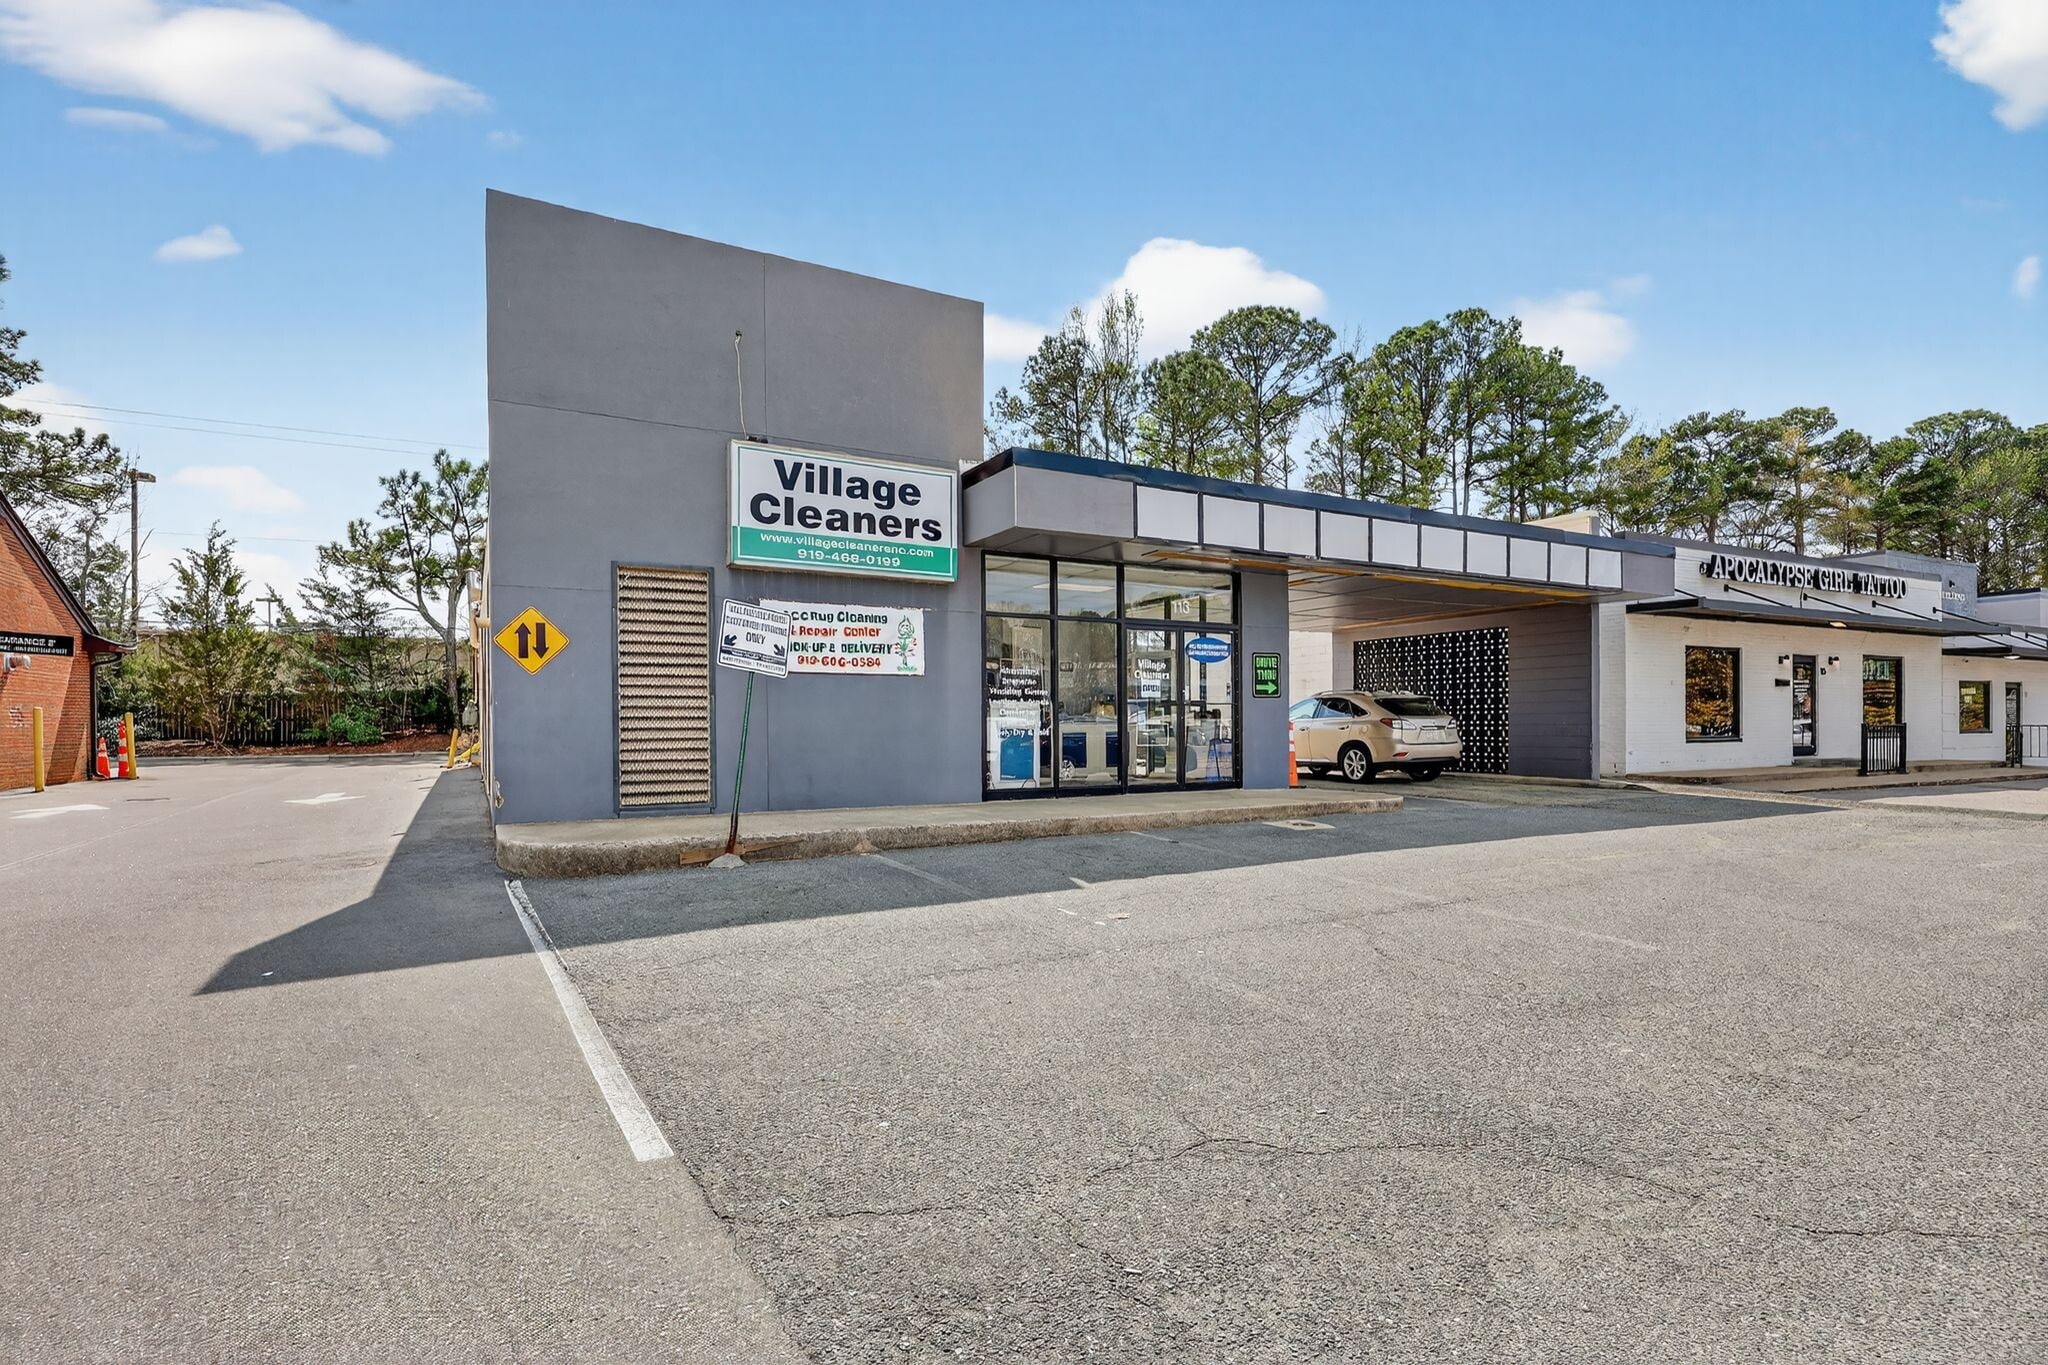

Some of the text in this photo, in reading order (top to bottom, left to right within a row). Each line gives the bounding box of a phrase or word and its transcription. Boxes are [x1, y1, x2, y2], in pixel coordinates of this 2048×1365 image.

[773, 459, 922, 510] Village
[750, 493, 942, 542] Cleaners
[1711, 554, 1909, 599] APOCALYPSE GIRL TATTOO
[841, 641, 893, 654] DELIVERY
[1256, 657, 1277, 668] DRIVE
[1257, 669, 1277, 680] THRU
